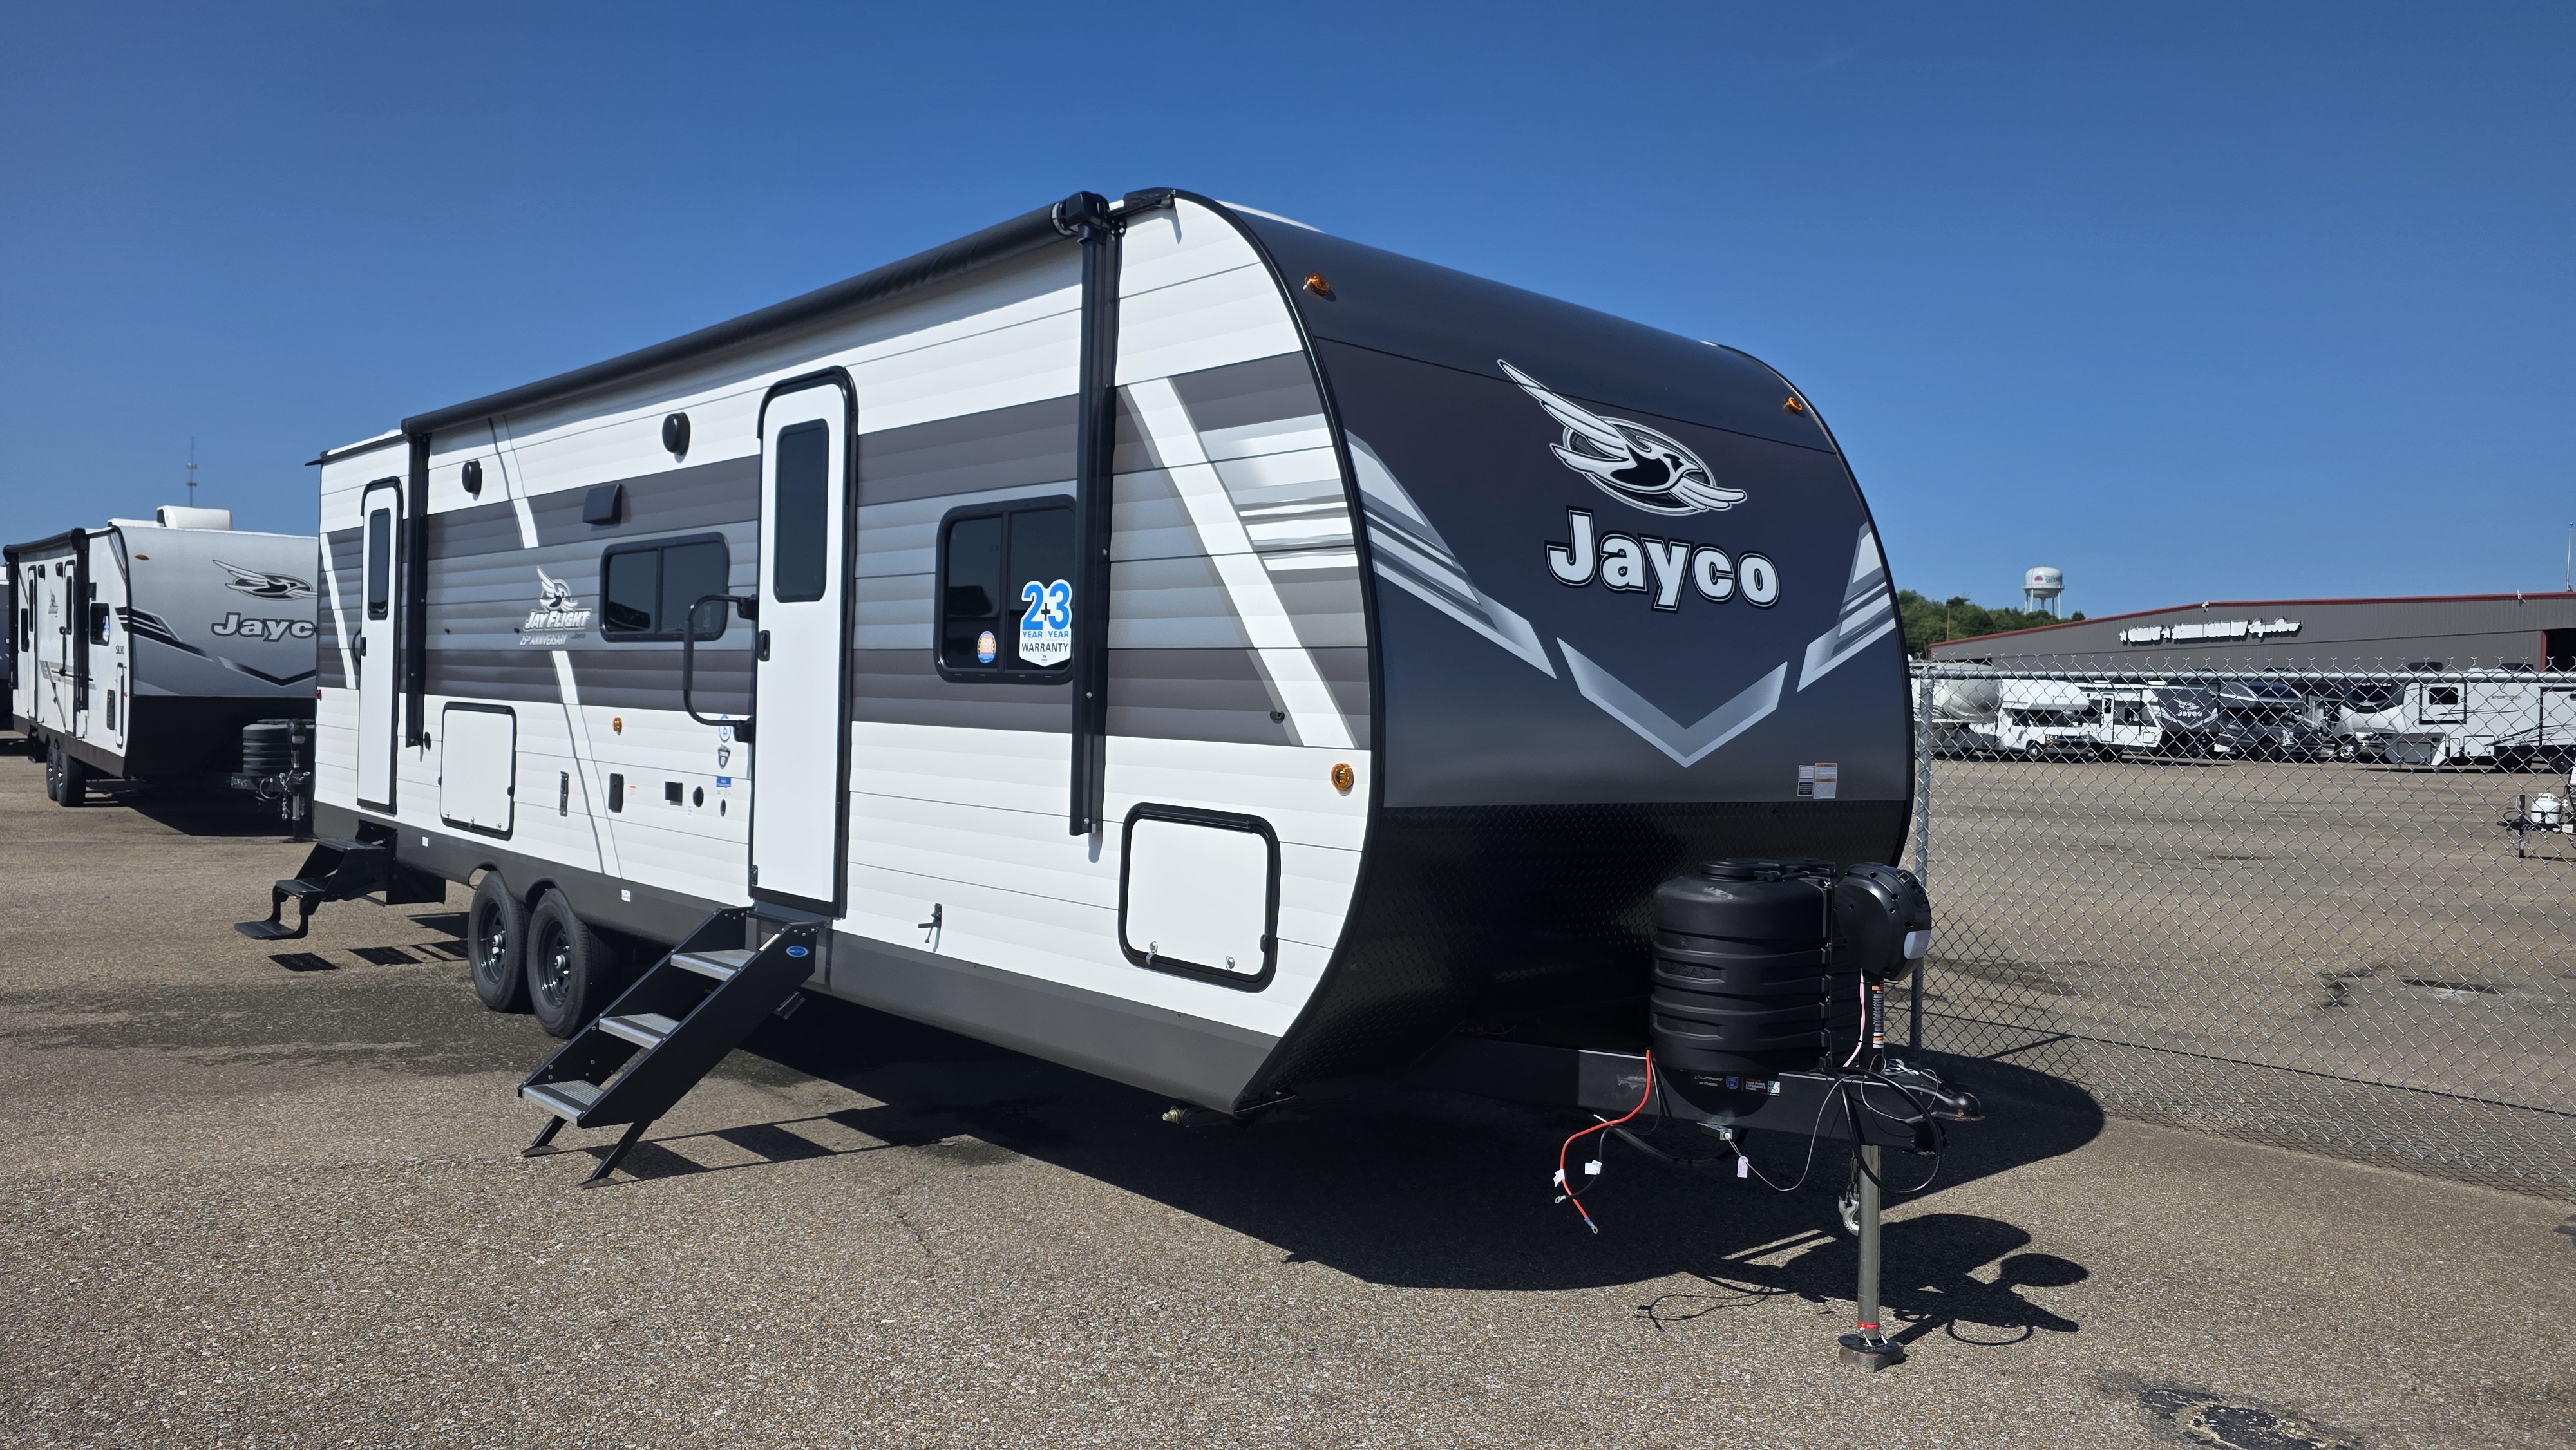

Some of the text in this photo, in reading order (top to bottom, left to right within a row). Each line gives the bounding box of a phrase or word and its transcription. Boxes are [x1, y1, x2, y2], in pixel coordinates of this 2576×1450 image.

[1544, 505, 1781, 614] Jayco
[211, 612, 317, 642] Jayc
[524, 608, 592, 632] JAY FLIGHT
[1021, 643, 1068, 652] WARRANTY
[1679, 965, 1707, 979] GAS
